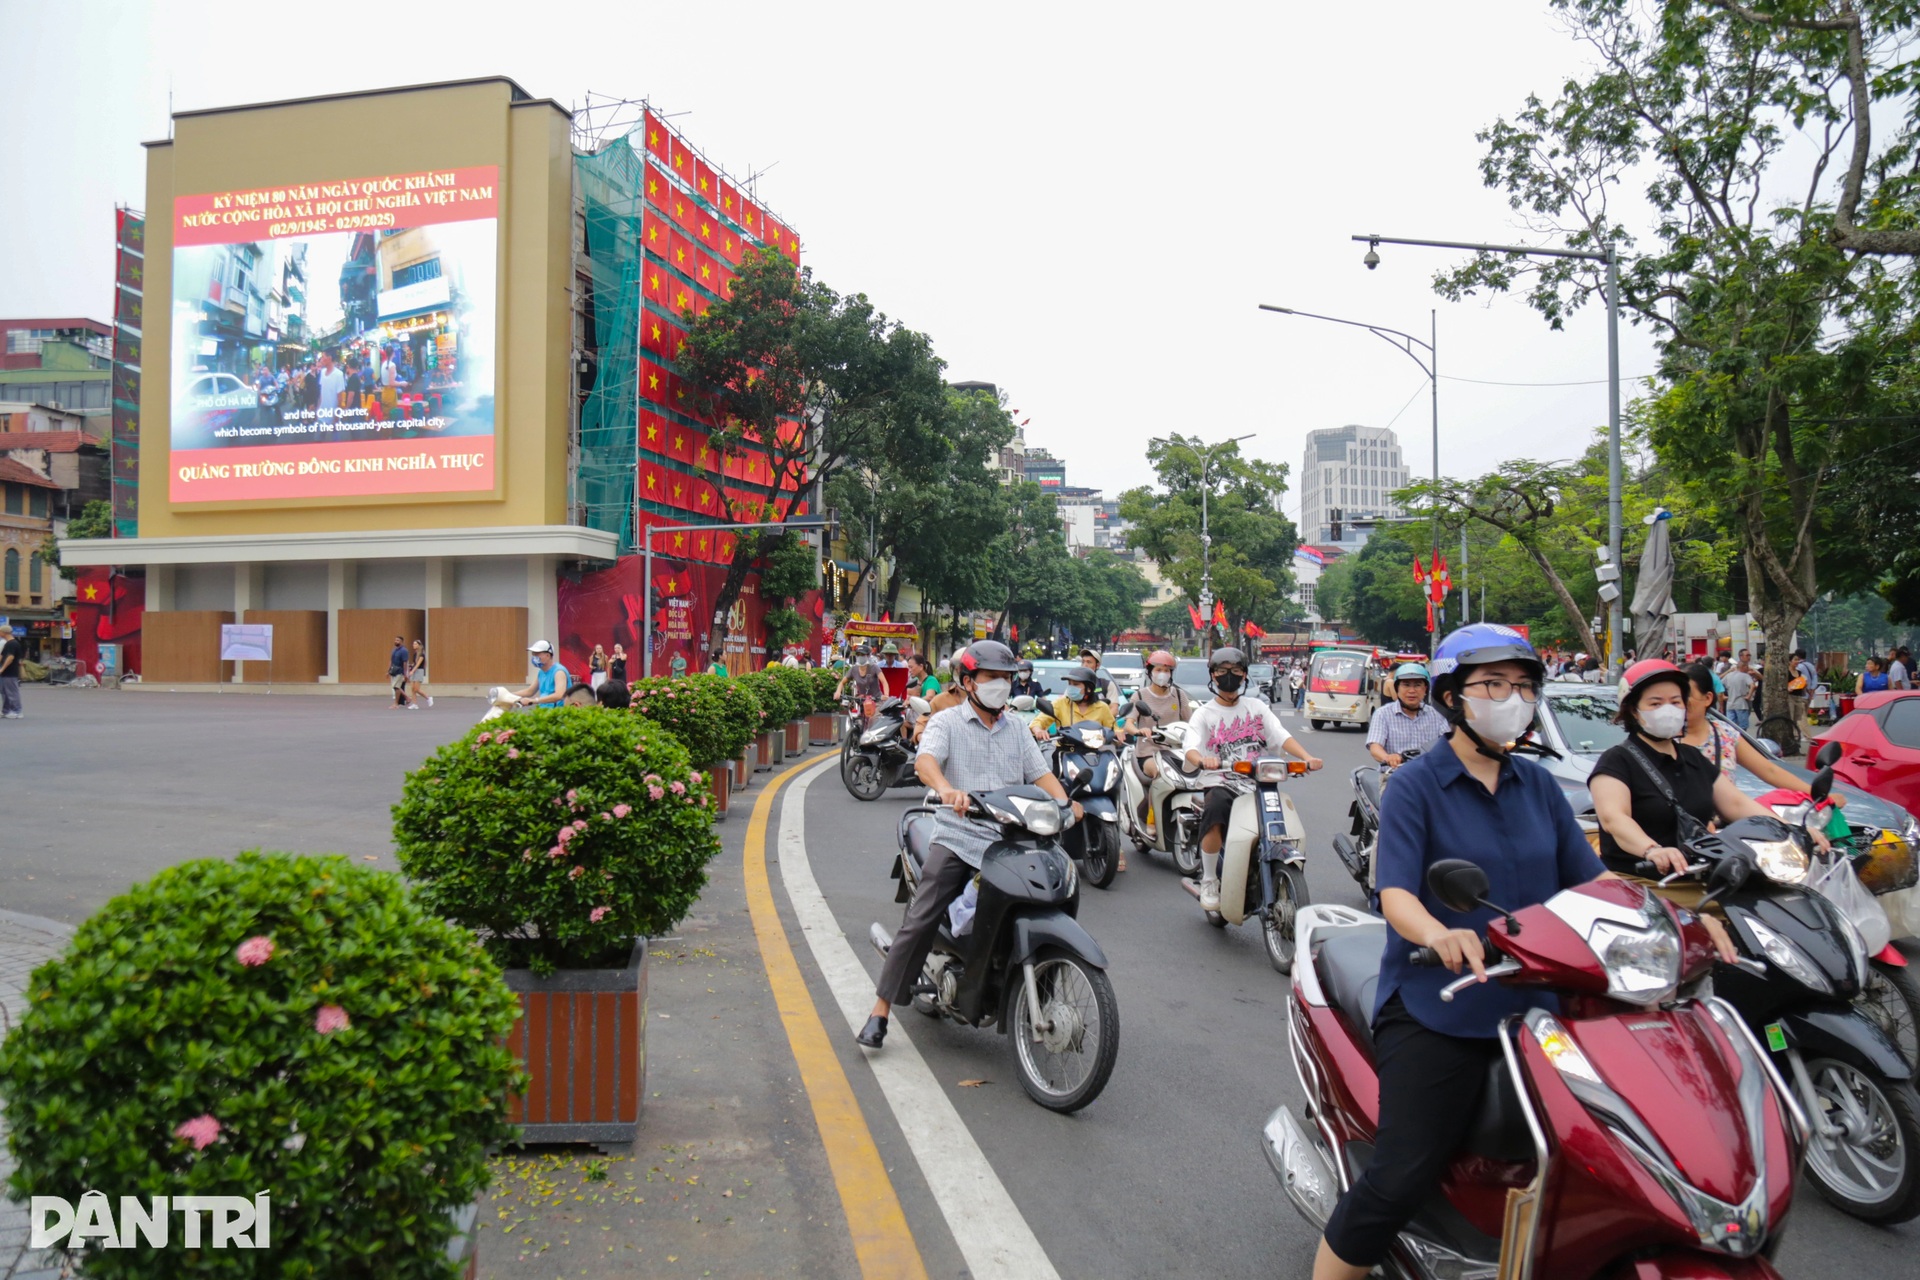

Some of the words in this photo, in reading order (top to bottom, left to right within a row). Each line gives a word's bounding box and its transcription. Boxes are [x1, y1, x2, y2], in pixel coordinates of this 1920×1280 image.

[214, 193, 233, 209] KỶ
[235, 191, 269, 207] NIỆM
[272, 190, 285, 203] 80
[288, 186, 318, 201] NĂM
[322, 181, 360, 198] NGÀY
[362, 178, 402, 195] QUỐC
[405, 172, 455, 190] KHÁNH
[183, 210, 220, 227] NƯỚC
[223, 209, 260, 225] CỘNG
[263, 205, 292, 220] HÒA
[295, 202, 313, 217] XÃ
[316, 200, 341, 216] HỘI
[344, 195, 373, 211] CHỦ
[376, 193, 420, 209] NGHĨA
[424, 189, 457, 206] VIỆT
[460, 186, 493, 201] NAM
[269, 219, 327, 238] (02/9/1945
[336, 213, 395, 230] 02/9/2025)
[284, 410, 299, 420] and
[301, 409, 315, 419] the
[317, 408, 333, 418] Old
[334, 407, 369, 419] Quarter,
[214, 427, 238, 438] which
[240, 425, 272, 437] become
[273, 423, 307, 437] symbols
[308, 422, 318, 433] of
[319, 422, 334, 433] the
[335, 420, 395, 433] thousand-year
[397, 417, 426, 431] capital
[427, 416, 446, 429] city.
[178, 463, 230, 482] QUẢNG
[232, 459, 295, 478] TRƯỜNG
[298, 456, 341, 475] ĐÔNG
[344, 456, 384, 473] KINH
[387, 452, 437, 470] NGHĨA
[440, 452, 484, 472] THỤC
[668, 597, 679, 609] VIỆT
[679, 600, 689, 608] NAM
